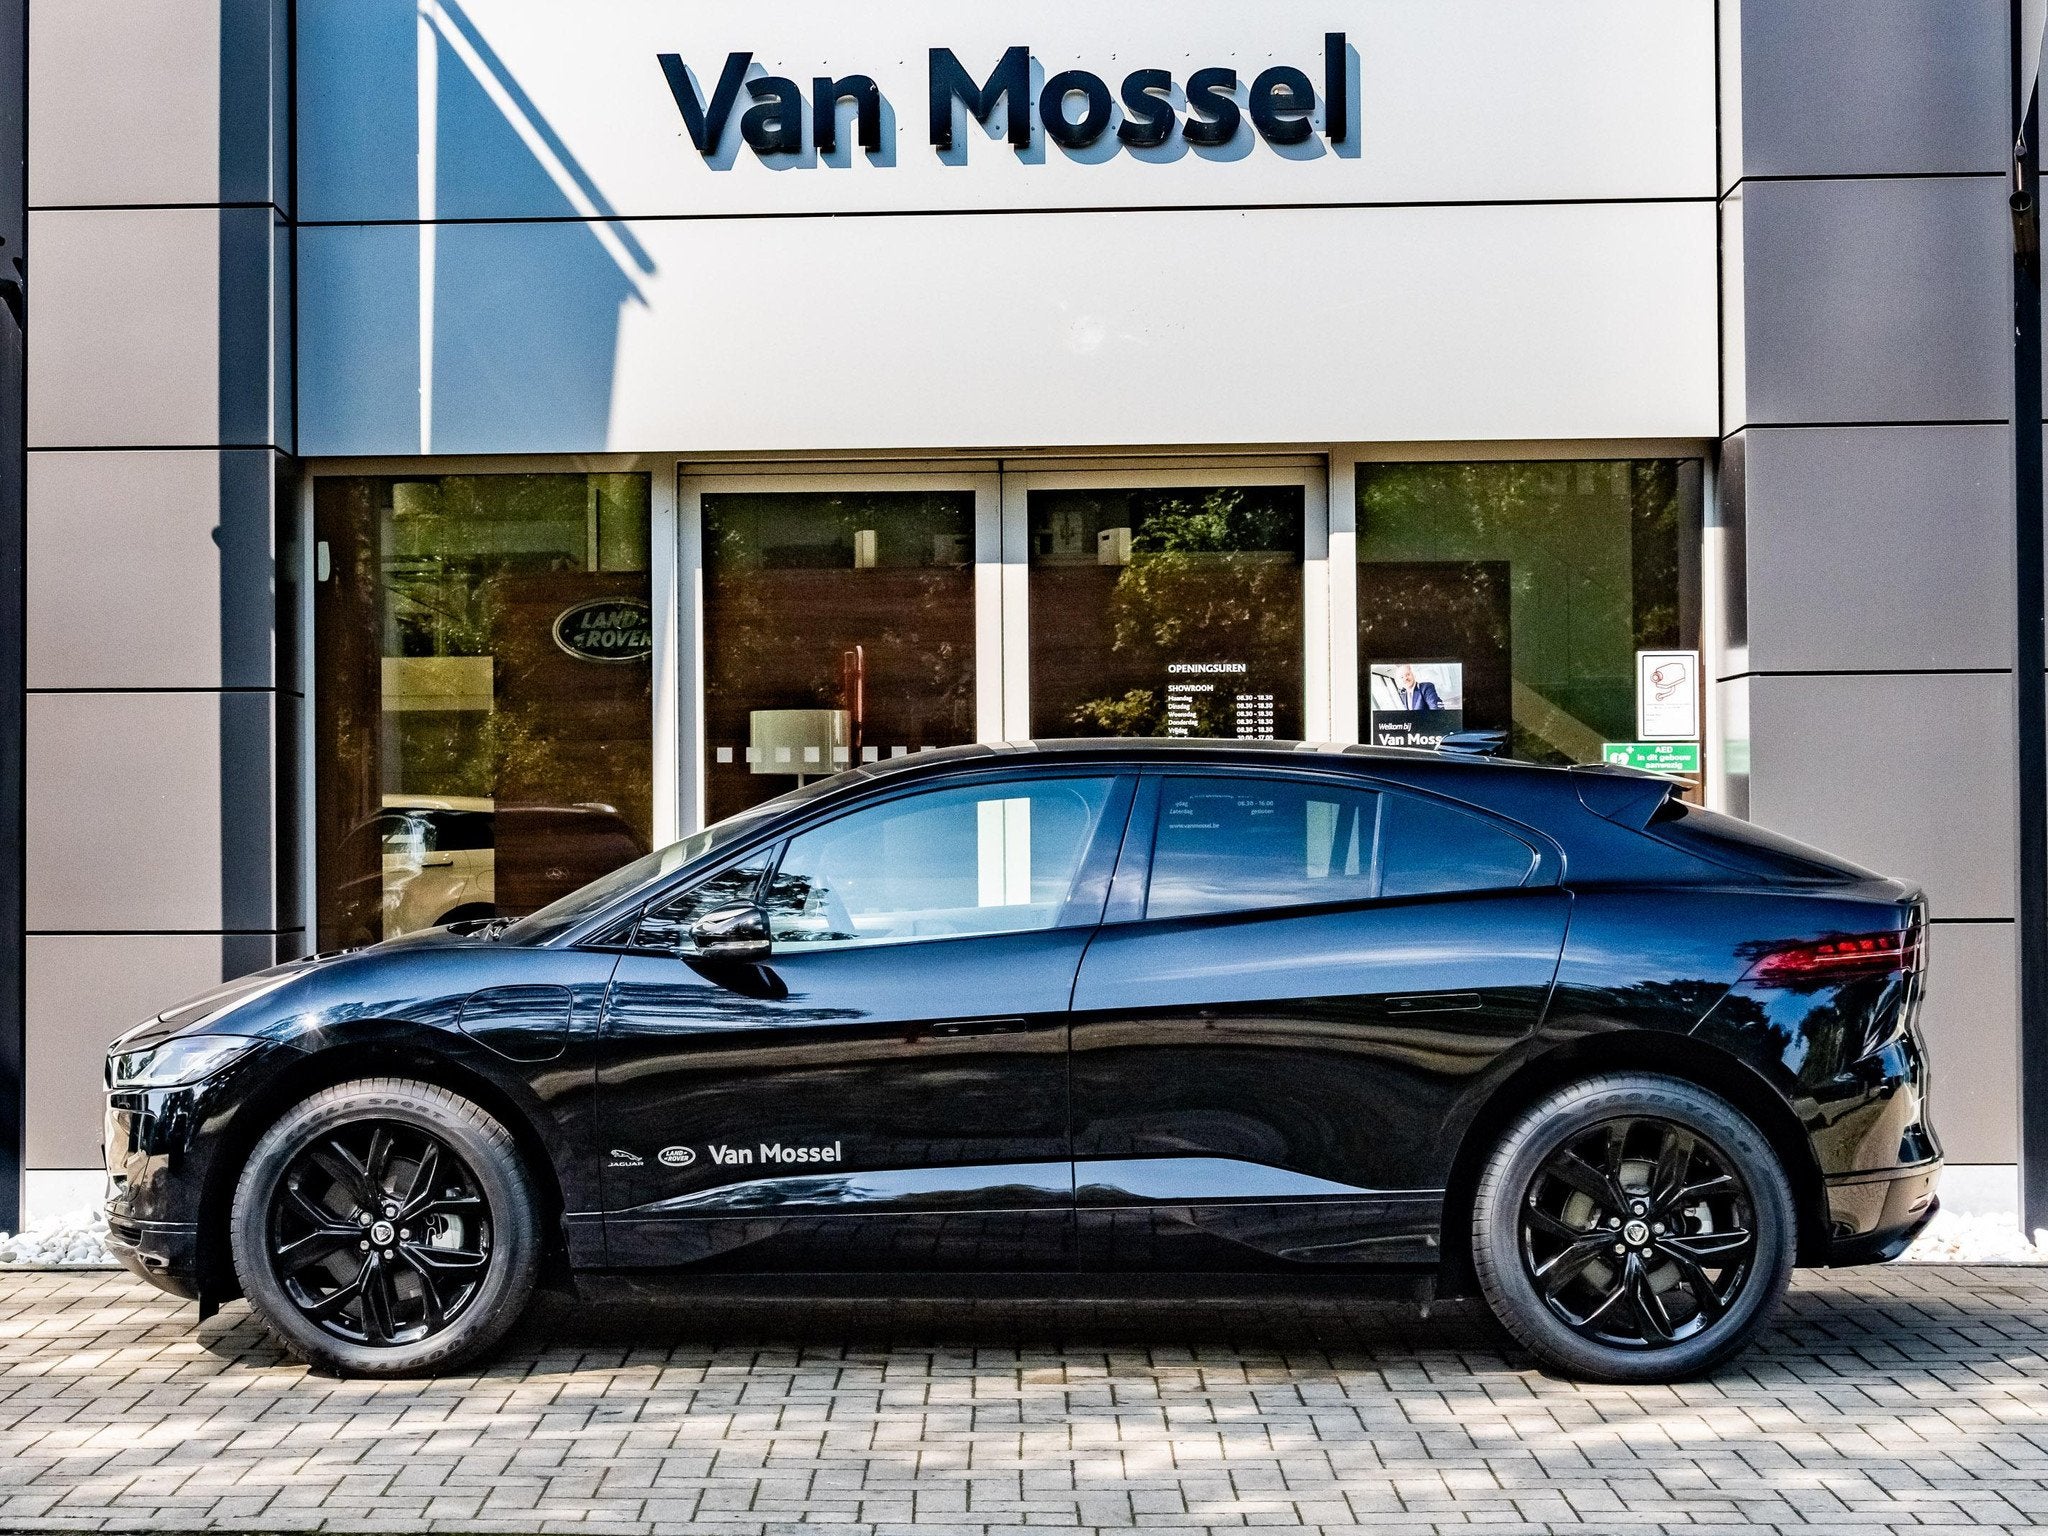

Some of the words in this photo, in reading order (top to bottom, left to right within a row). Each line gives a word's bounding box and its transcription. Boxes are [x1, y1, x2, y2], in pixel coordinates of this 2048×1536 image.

[656, 51, 881, 154] Van
[928, 32, 1347, 147] Mossel
[581, 608, 639, 628] LAND
[1167, 663, 1247, 673] OPENINGSUREN
[1167, 684, 1214, 692] SHOWROOM
[1378, 722, 1403, 730] Welkom
[1403, 722, 1412, 732] bij
[1378, 733, 1405, 746] Van
[1407, 732, 1454, 745] Moss
[1646, 753, 1659, 761] dit
[1659, 754, 1692, 763] gebouw
[368, 1098, 447, 1120] SPORT
[708, 1144, 753, 1165] Van
[759, 1140, 842, 1164] Mossel
